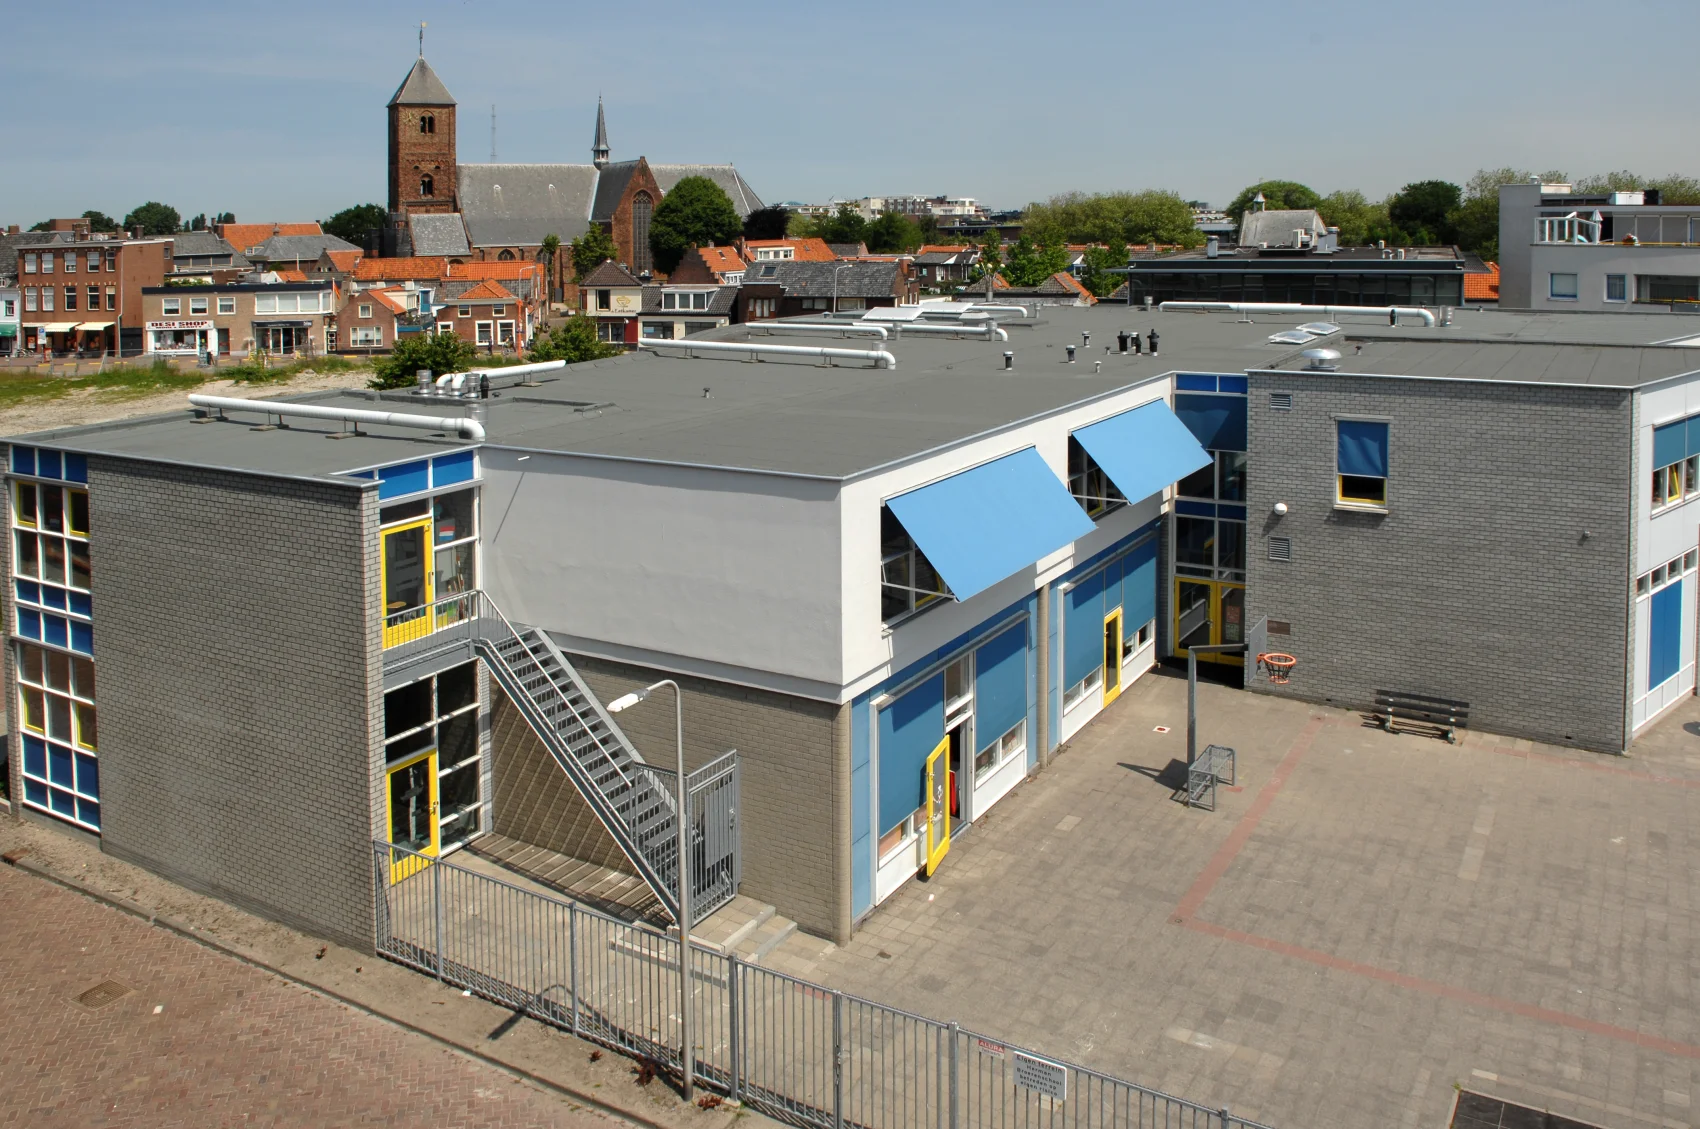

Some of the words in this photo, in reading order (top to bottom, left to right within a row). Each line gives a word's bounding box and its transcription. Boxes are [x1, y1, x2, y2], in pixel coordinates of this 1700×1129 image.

[980, 1042, 1004, 1052] ALURA
[1016, 1054, 1036, 1064] Eigen
[1026, 1065, 1052, 1076] Herman
[1020, 1074, 1048, 1086] betreden
[1020, 1081, 1038, 1090] eigen
[1040, 1087, 1057, 1096] risico
